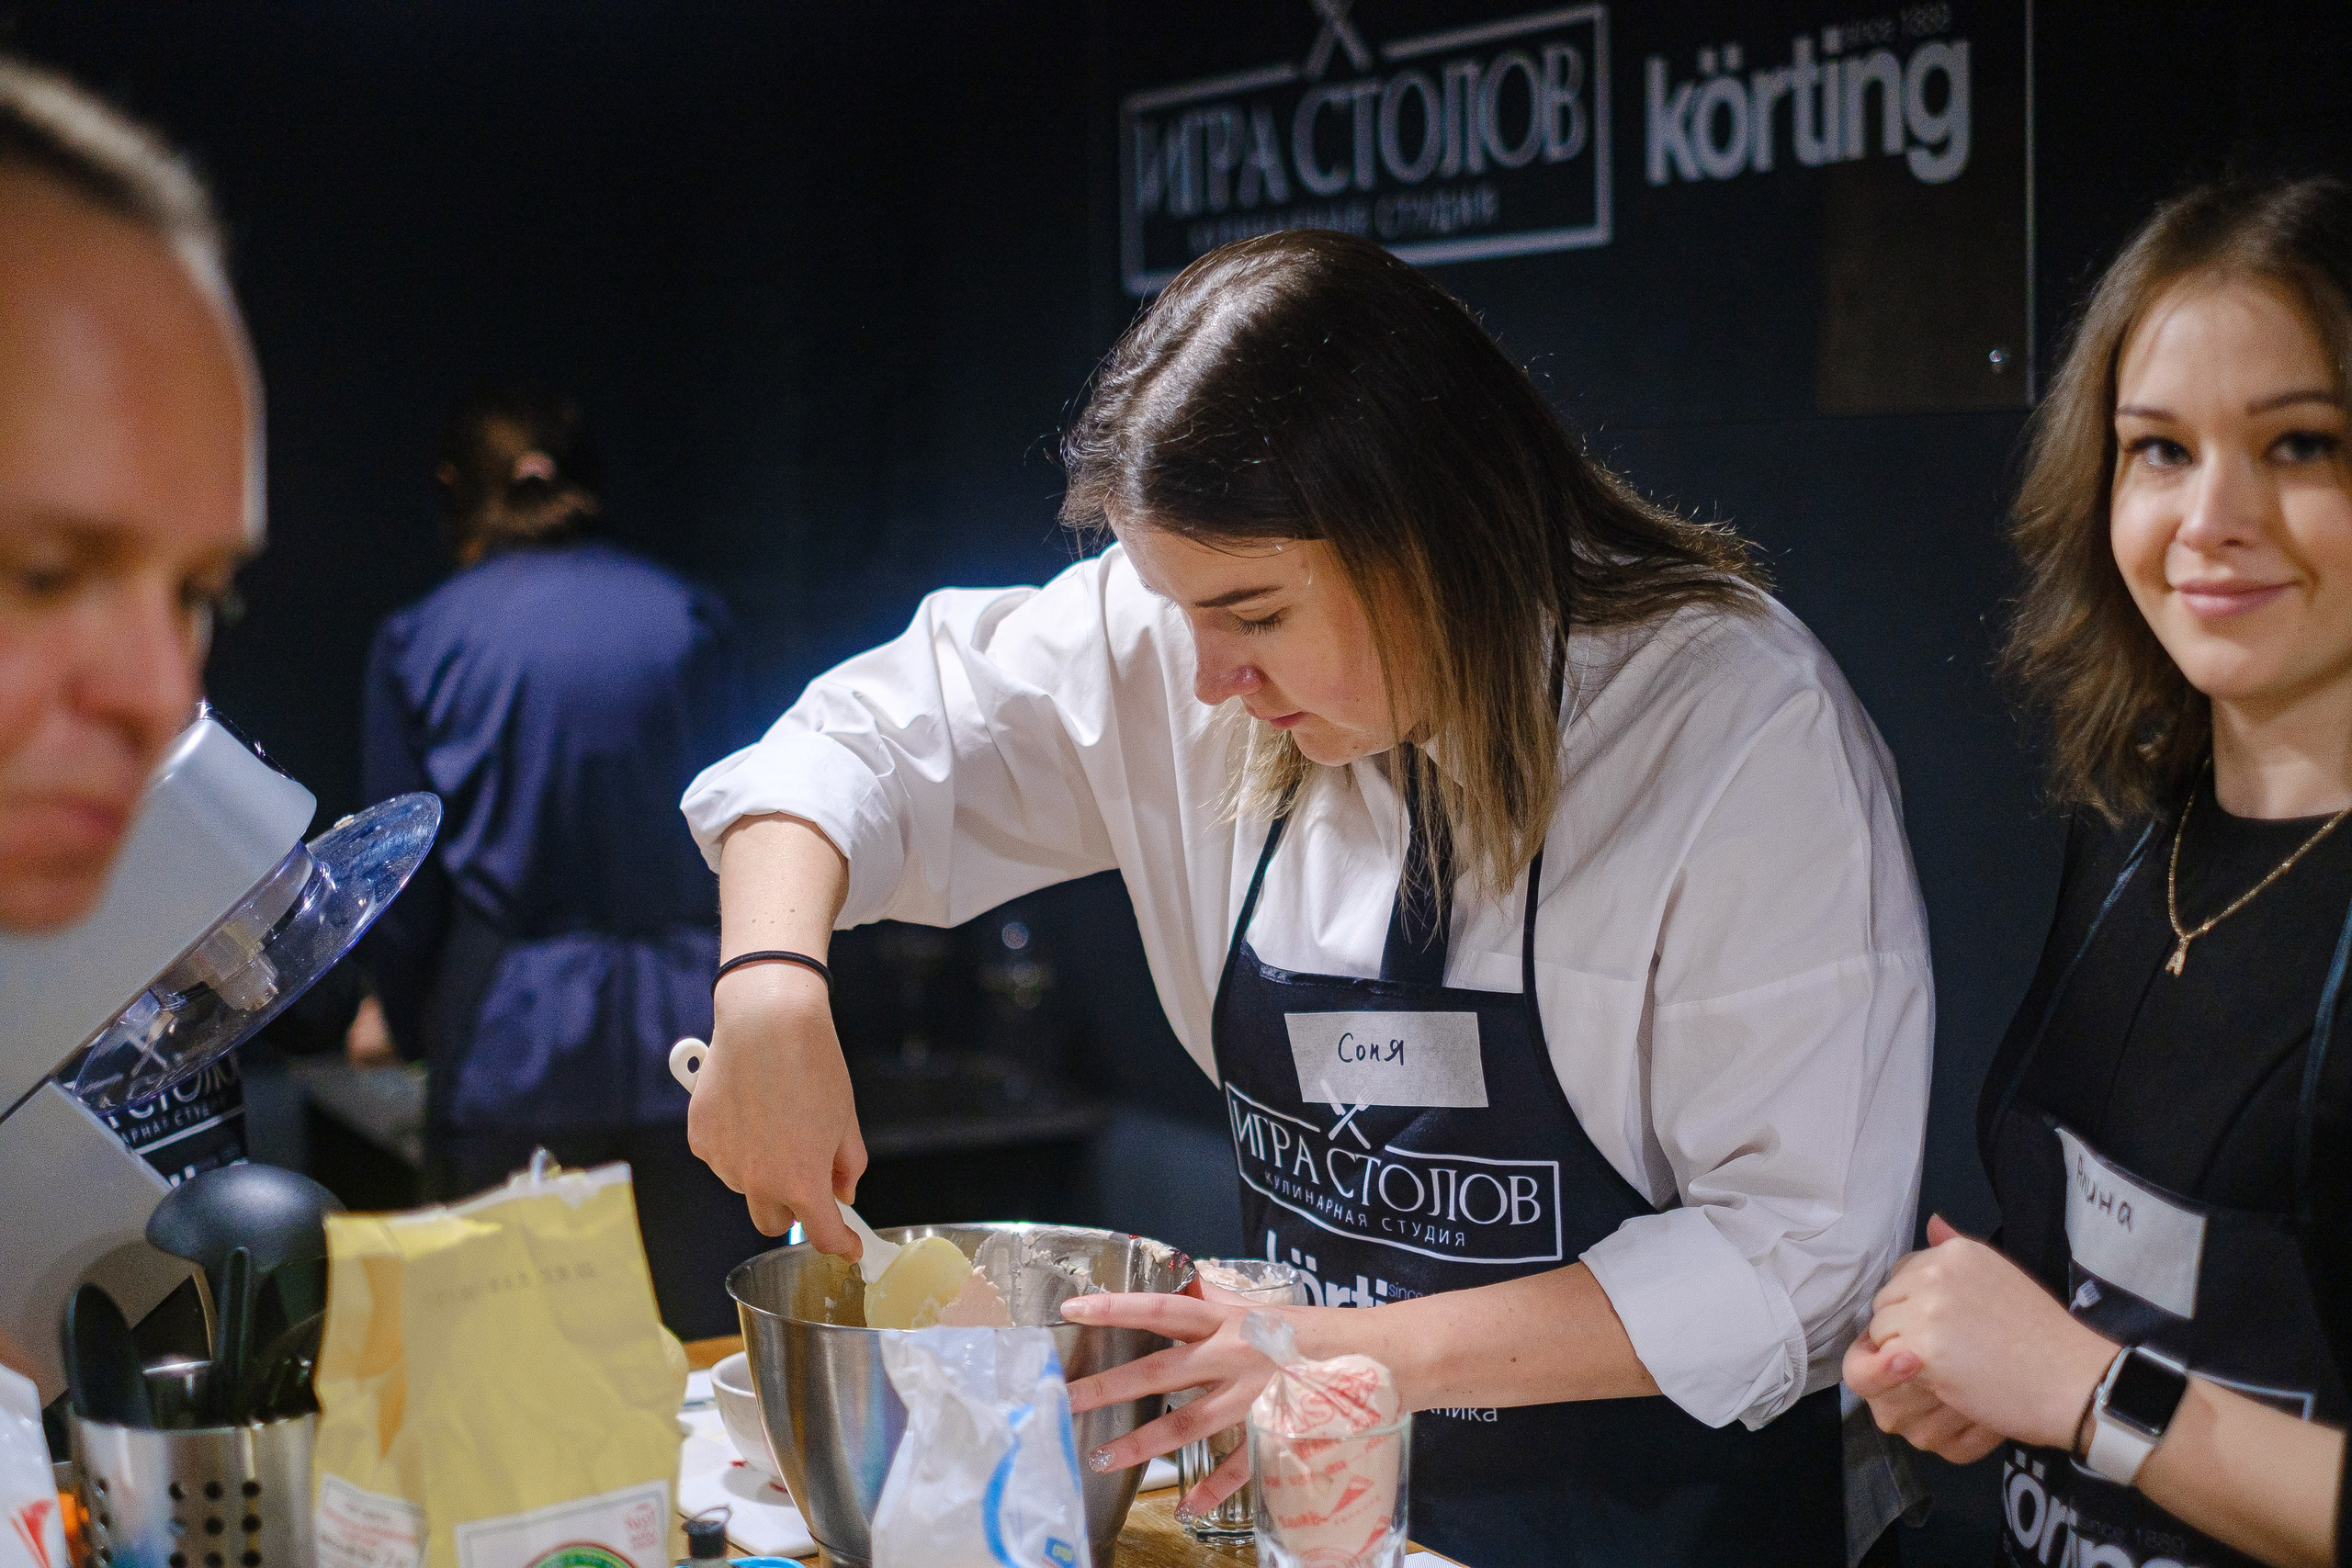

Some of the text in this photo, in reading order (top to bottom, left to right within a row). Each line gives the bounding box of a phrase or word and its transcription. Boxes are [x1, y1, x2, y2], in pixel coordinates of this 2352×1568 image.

[1134, 42, 1589, 219] ИГРА СТОЛОВ
[1646, 37, 1972, 185] körting
[1338, 1032, 1406, 1066] Соня
[1231, 1099, 1542, 1226] ИГРА СТОЛОВ
[1264, 1170, 1465, 1247] КУЛИНАРНАЯ СТУДИЯ
